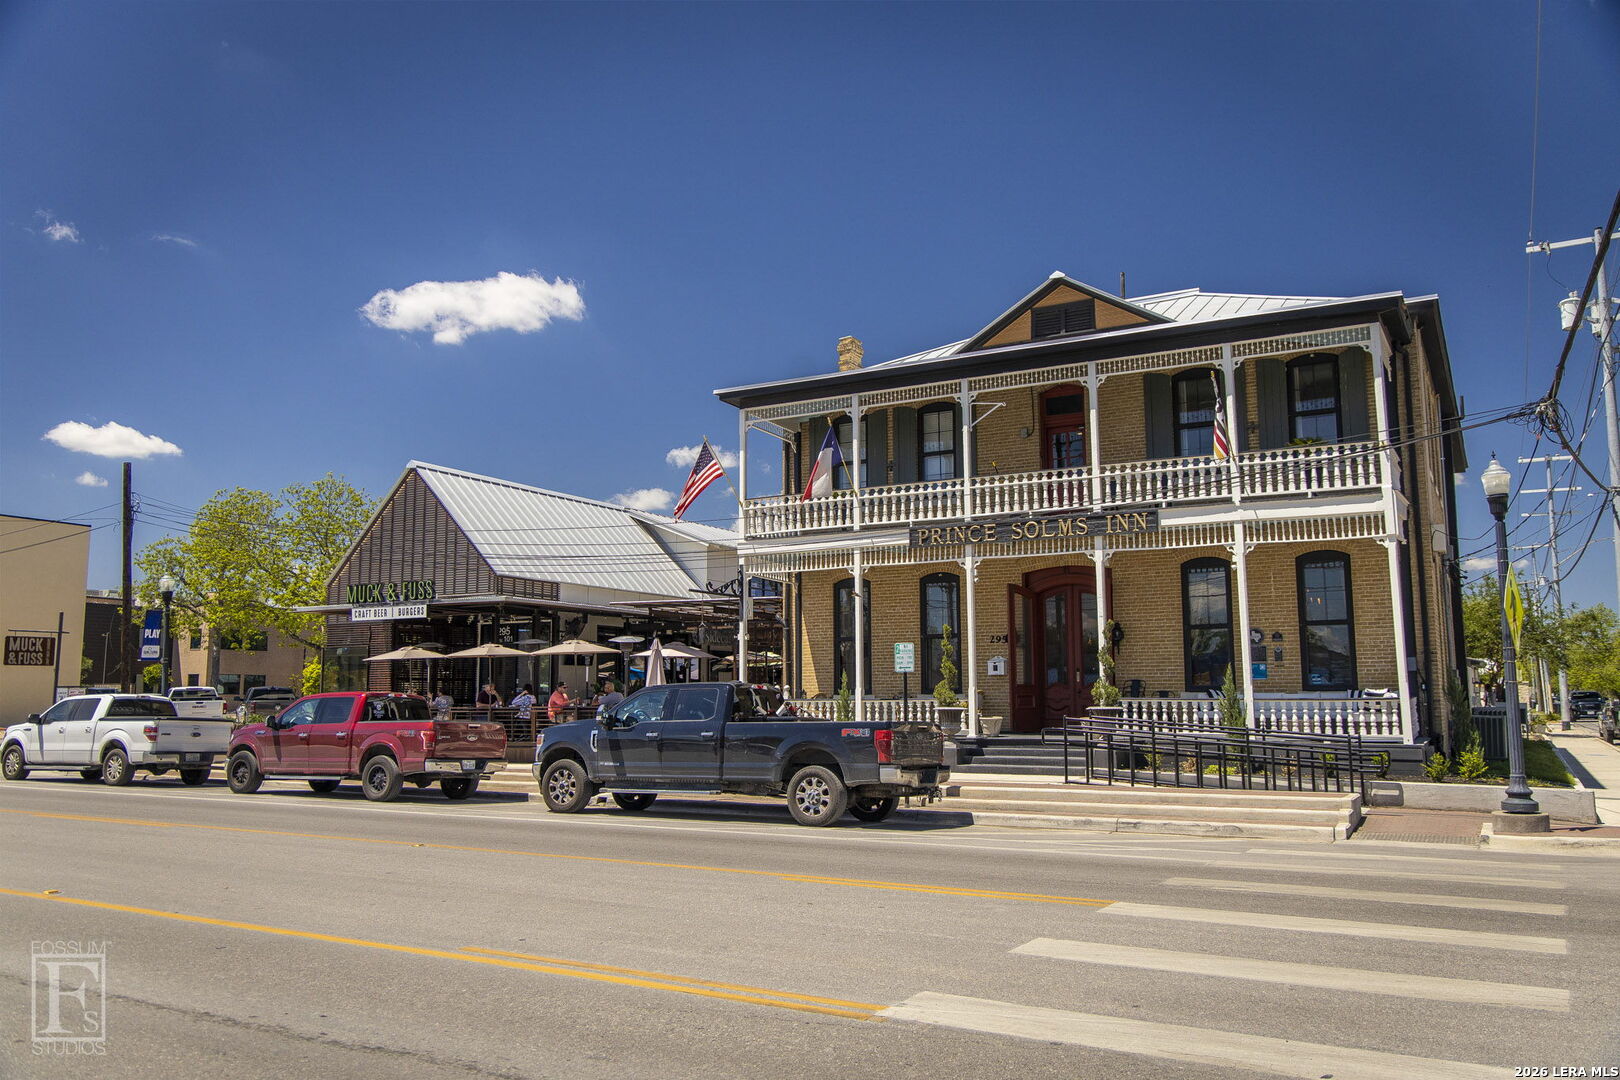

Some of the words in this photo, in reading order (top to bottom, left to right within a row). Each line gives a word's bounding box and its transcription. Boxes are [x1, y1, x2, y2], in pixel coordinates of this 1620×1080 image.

[917, 523, 997, 546] PRINCE
[1011, 517, 1089, 540] SOLMS
[1105, 512, 1148, 533] INN
[345, 583, 382, 603] MUCK
[387, 582, 397, 601] &
[402, 580, 434, 600] FUSS
[354, 609, 371, 618] CRAFT
[373, 608, 388, 618] BEER
[398, 606, 424, 616] BURGERS
[144, 628, 160, 639] PLAY
[990, 635, 1008, 643] 295
[9, 637, 43, 651] MUCK
